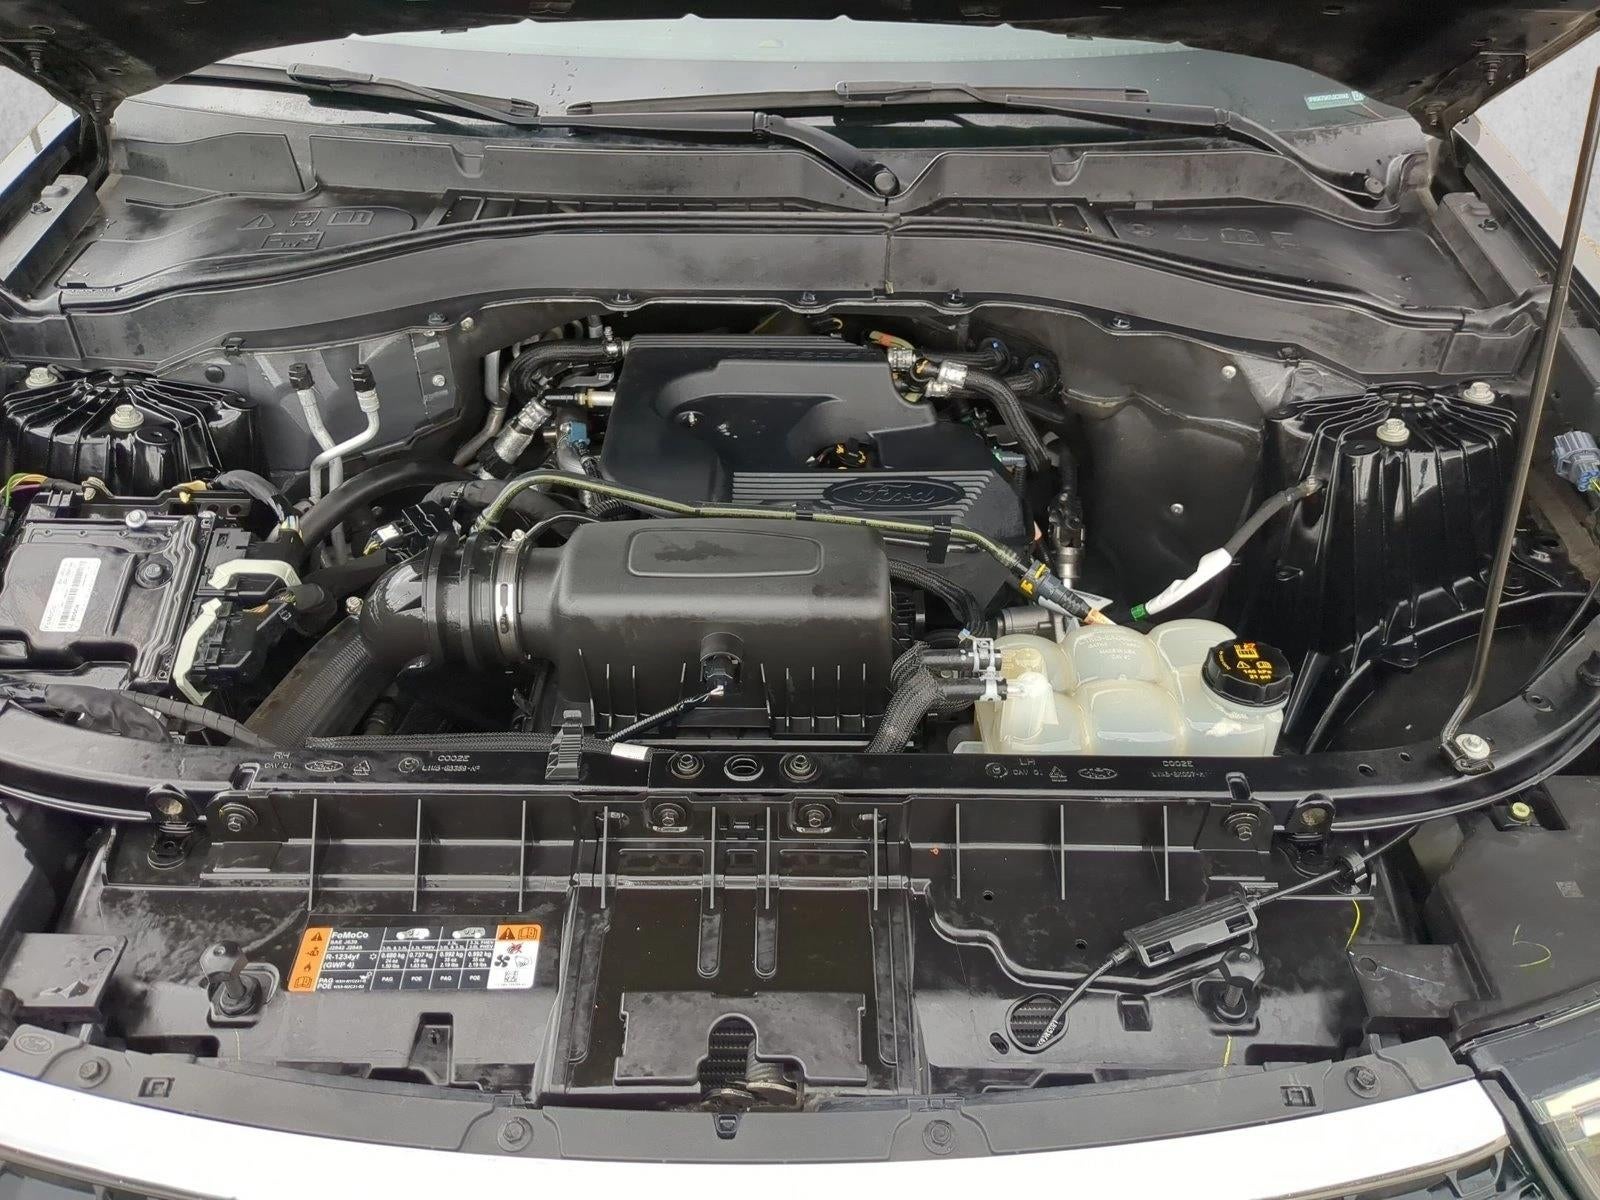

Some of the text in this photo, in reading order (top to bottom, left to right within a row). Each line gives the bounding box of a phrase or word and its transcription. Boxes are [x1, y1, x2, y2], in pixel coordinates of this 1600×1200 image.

[853, 483, 936, 502] Ford
[273, 751, 290, 759] RH
[331, 931, 369, 939] FoMoCo
[325, 953, 360, 961] R-1234yf
[322, 961, 355, 969] (GWP 4)
